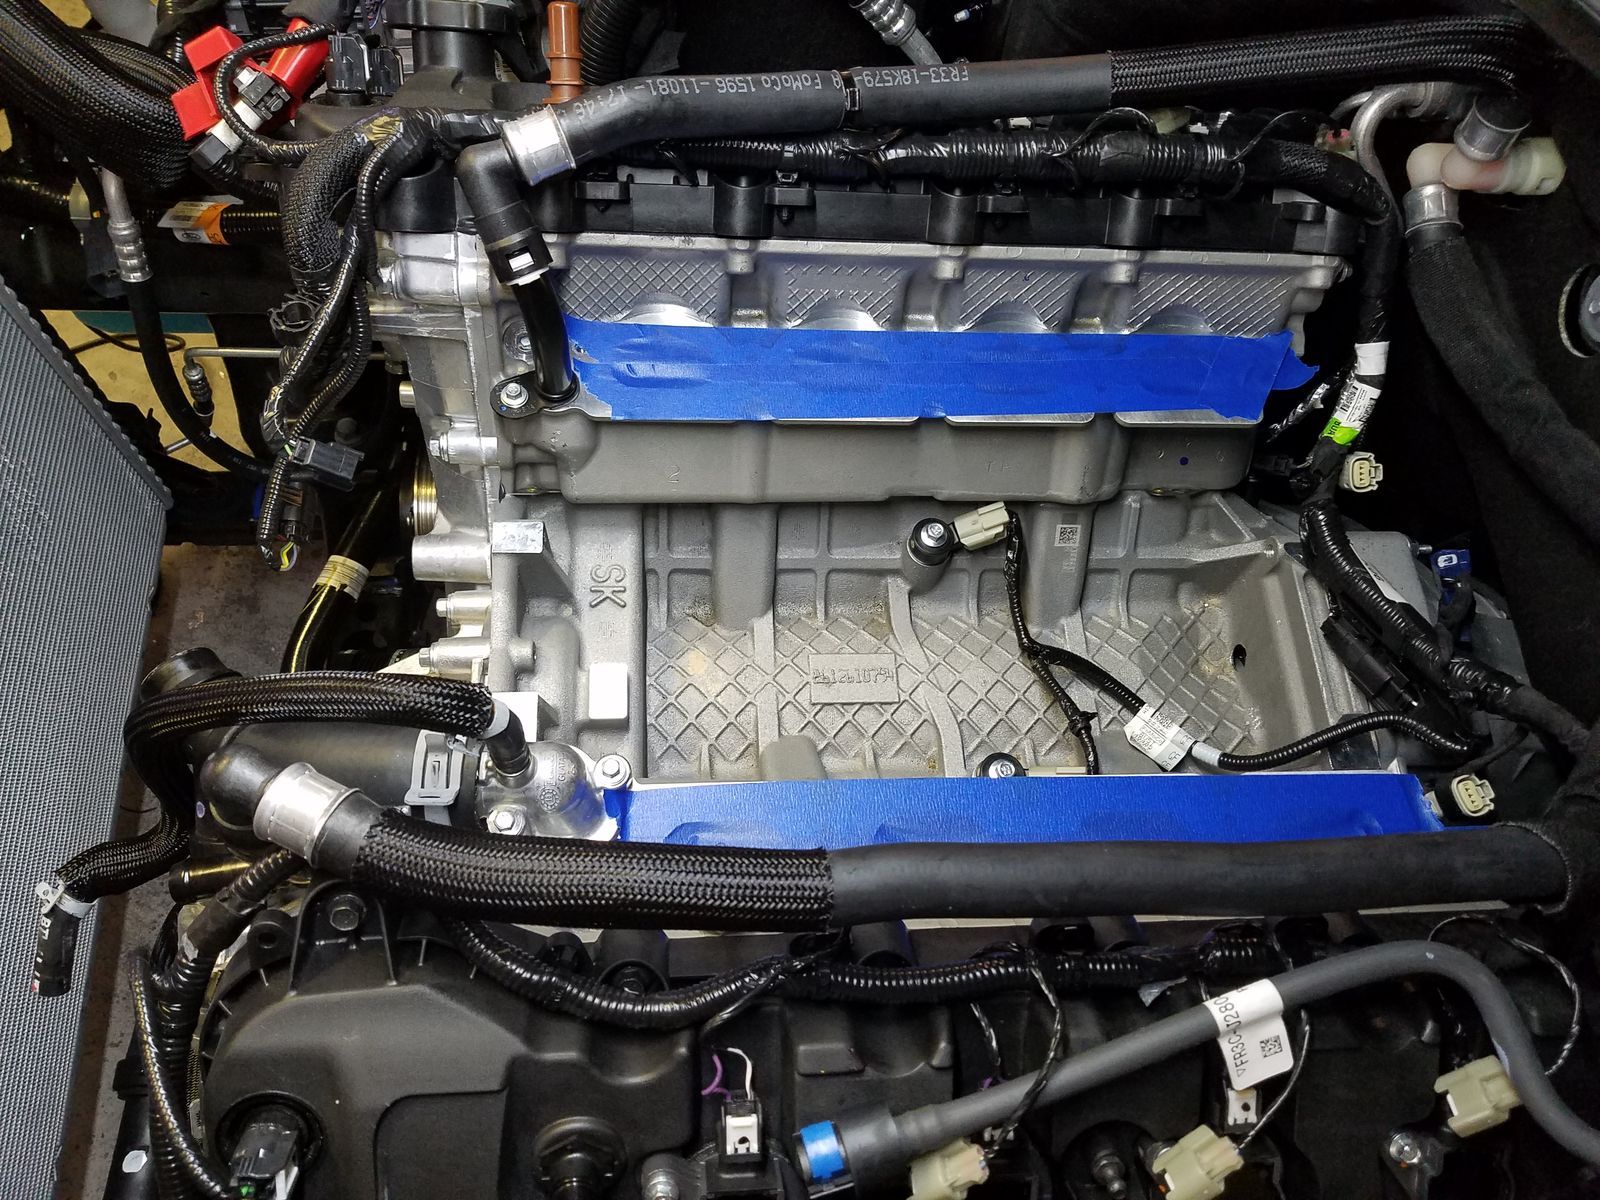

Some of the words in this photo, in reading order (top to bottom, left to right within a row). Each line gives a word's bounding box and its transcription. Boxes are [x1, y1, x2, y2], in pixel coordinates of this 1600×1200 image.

[715, 75, 756, 94] 1596
[761, 73, 822, 92] FoMoCo
[590, 564, 627, 608] SK
